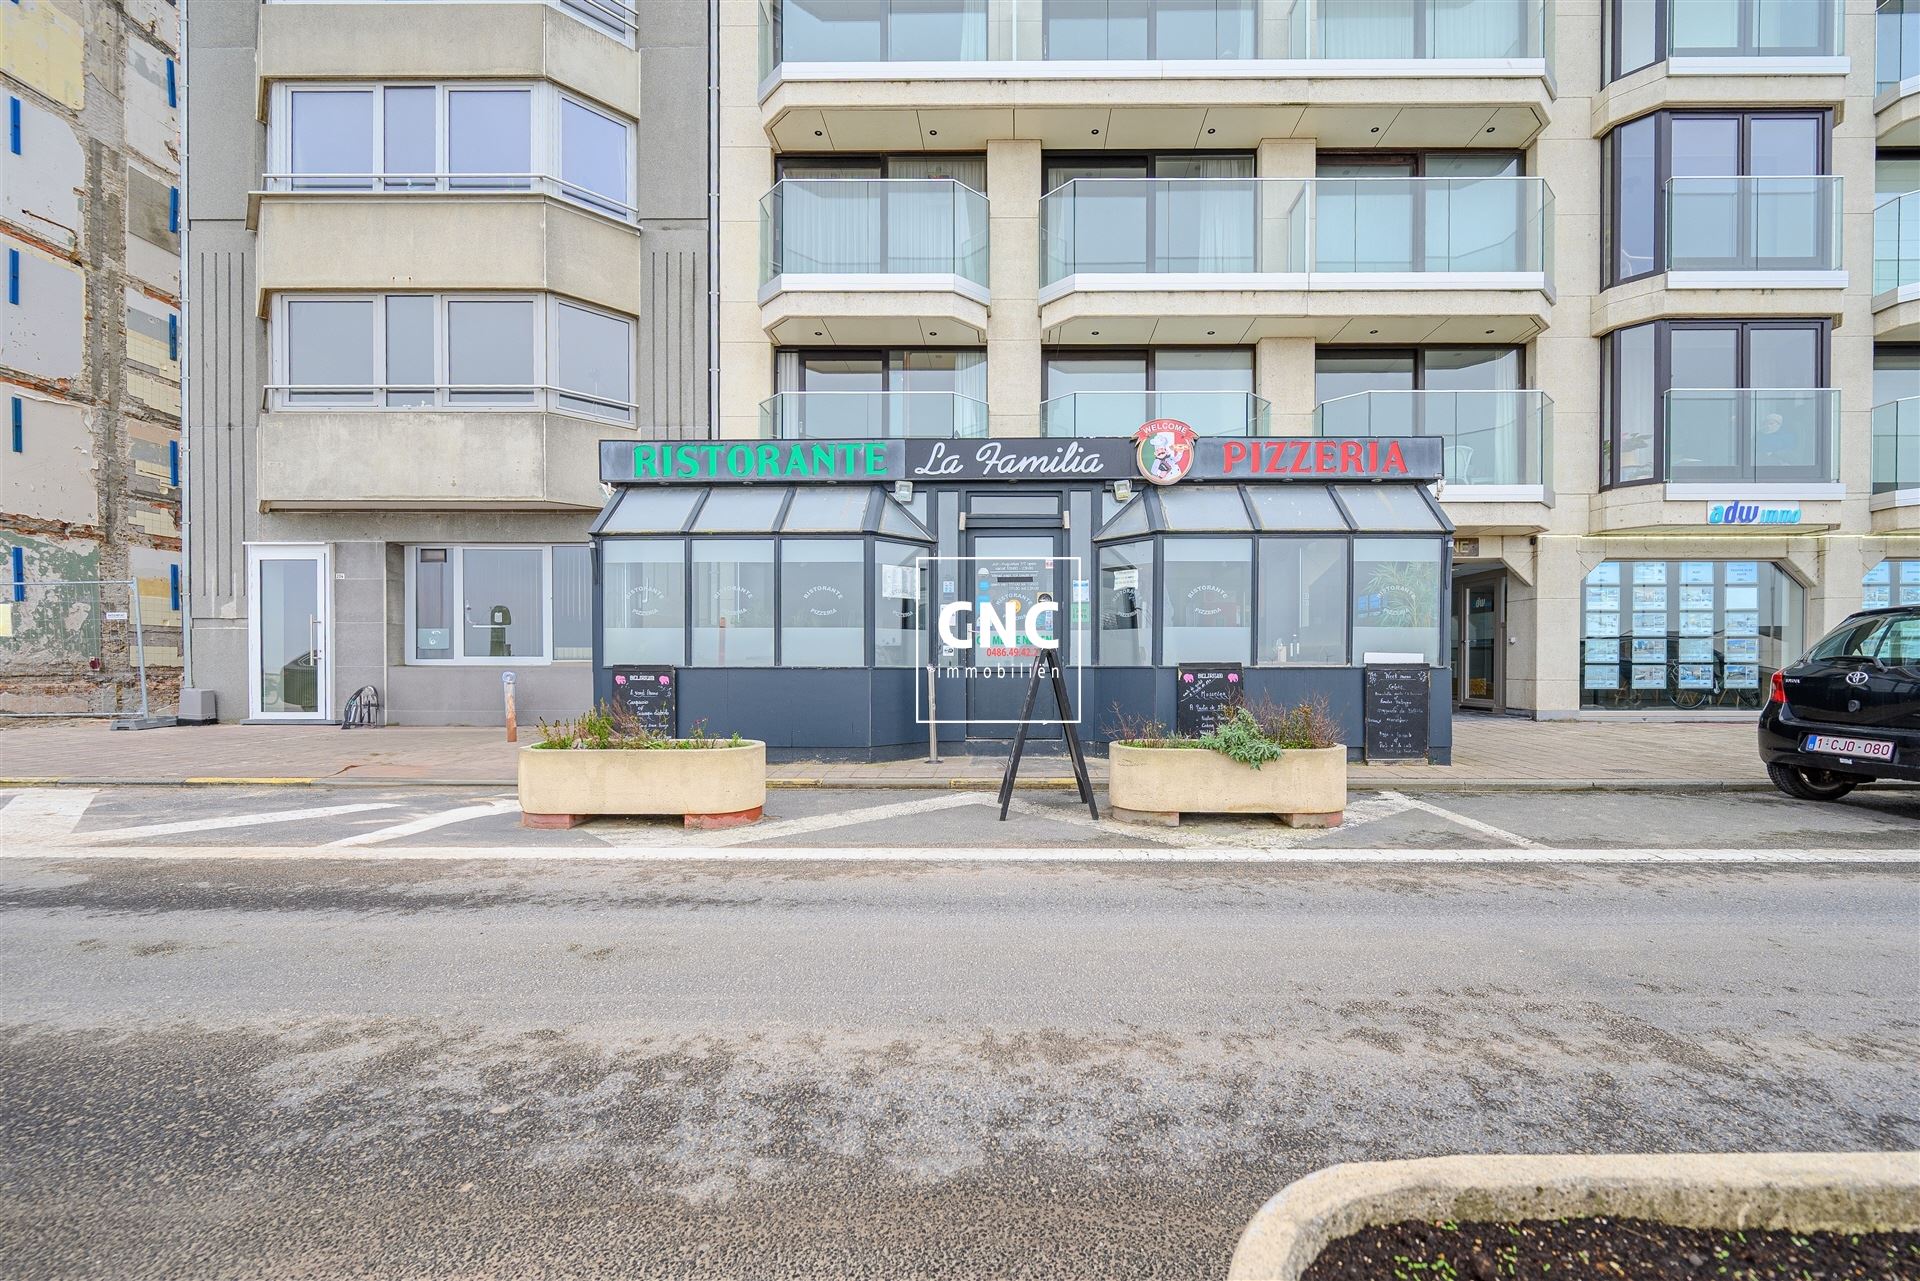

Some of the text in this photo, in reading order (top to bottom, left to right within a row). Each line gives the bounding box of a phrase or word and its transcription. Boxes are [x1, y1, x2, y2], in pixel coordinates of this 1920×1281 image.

[1143, 422, 1187, 435] WELCOME
[634, 444, 889, 477] RISTORANTE
[914, 441, 1104, 475] La Familia
[1222, 441, 1409, 475] PIZZERIA
[1710, 500, 1801, 523] adw immo
[803, 585, 844, 600] RISTORANTE
[1187, 585, 1228, 599] RISTORANTE
